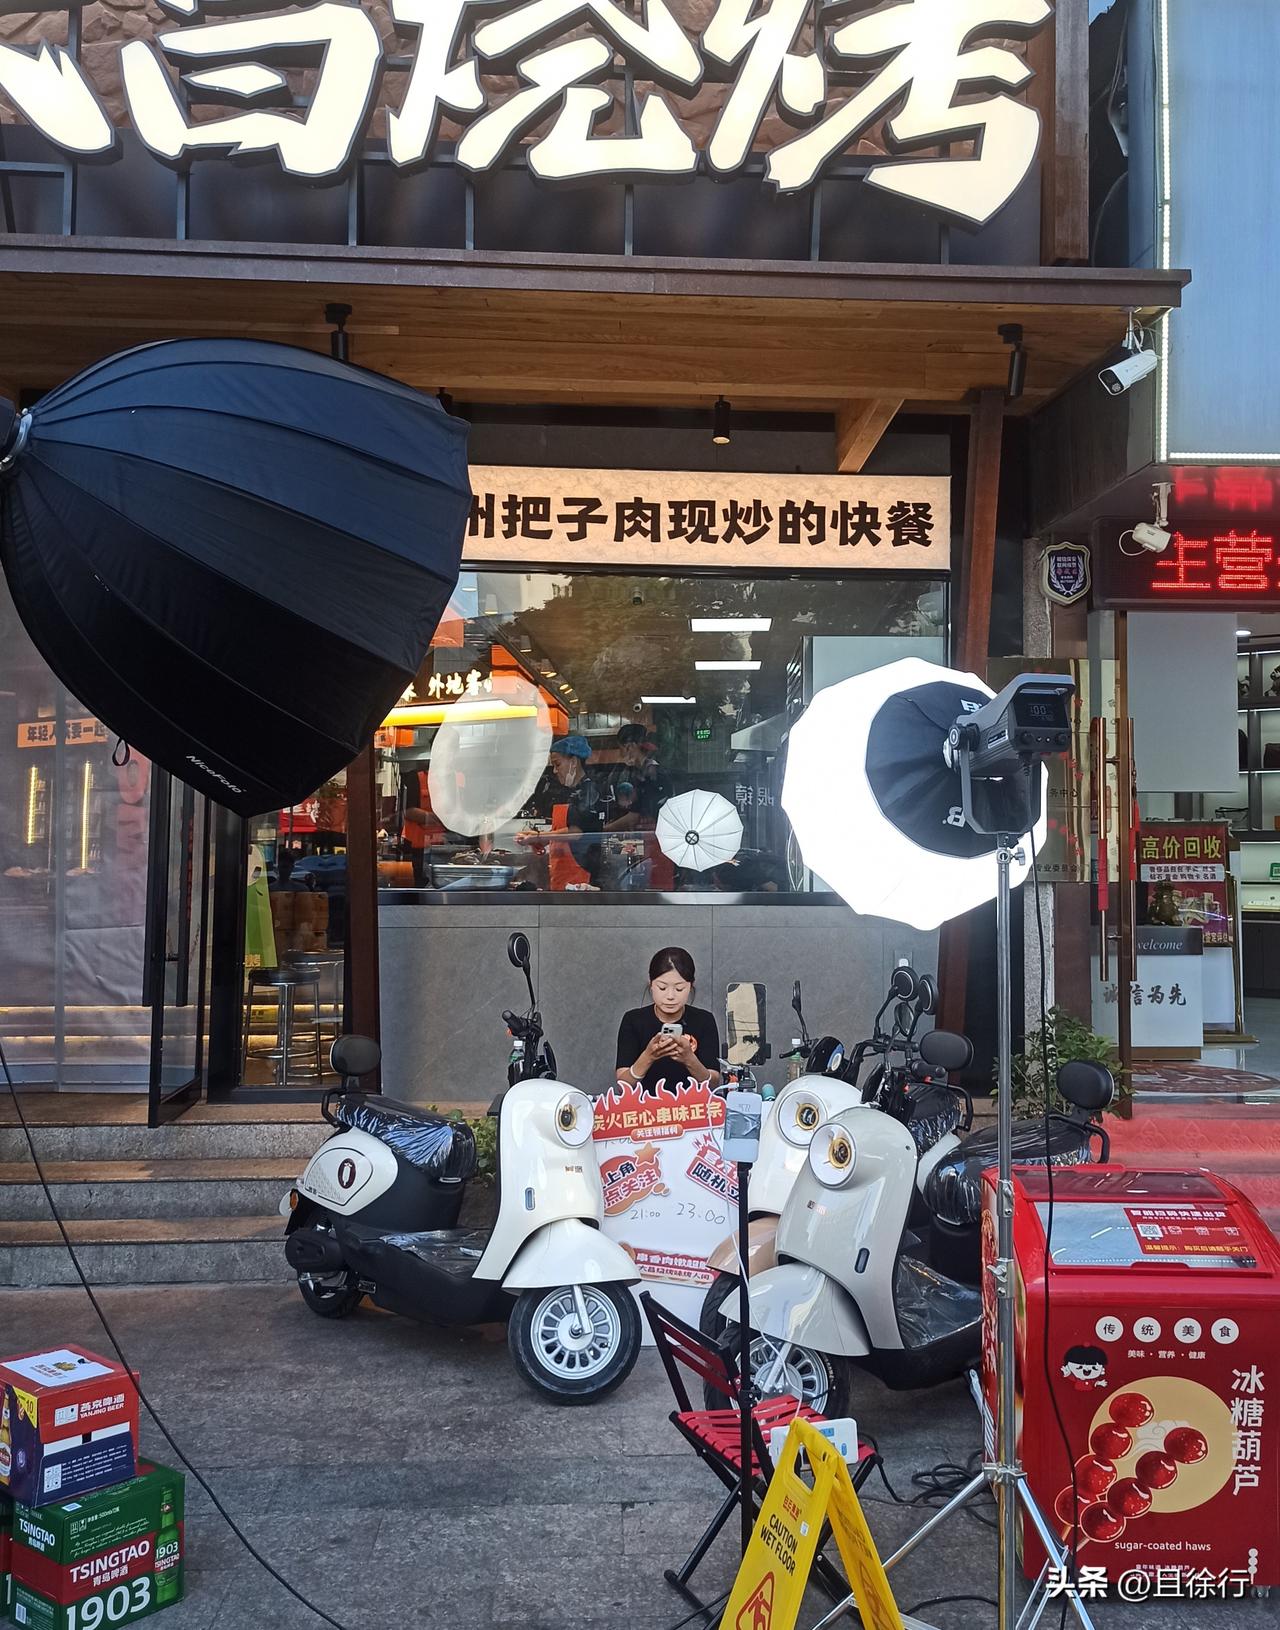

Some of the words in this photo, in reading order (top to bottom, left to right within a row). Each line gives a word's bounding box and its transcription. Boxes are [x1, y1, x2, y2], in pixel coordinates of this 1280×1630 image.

[1152, 530, 1280, 589] 主营
[185, 755, 242, 793] NiceFoto
[1141, 835, 1222, 859] 高价回收
[603, 1161, 635, 1188] 上角
[107, 1402, 125, 1413] BEER
[1230, 1365, 1265, 1496] 冰糖葫芦
[19, 1518, 55, 1547] TSINGTAO
[769, 1513, 798, 1555] CAUTION
[1115, 1541, 1182, 1551] sugar-coated
[1186, 1541, 1211, 1551] haws
[70, 1540, 150, 1583] TSINGTAO
[156, 1541, 179, 1559] 1903
[760, 1524, 777, 1550] WET
[775, 1541, 796, 1577] FLOOR
[93, 1564, 129, 1587] 青岛啤酒
[67, 1576, 151, 1630] 1903
